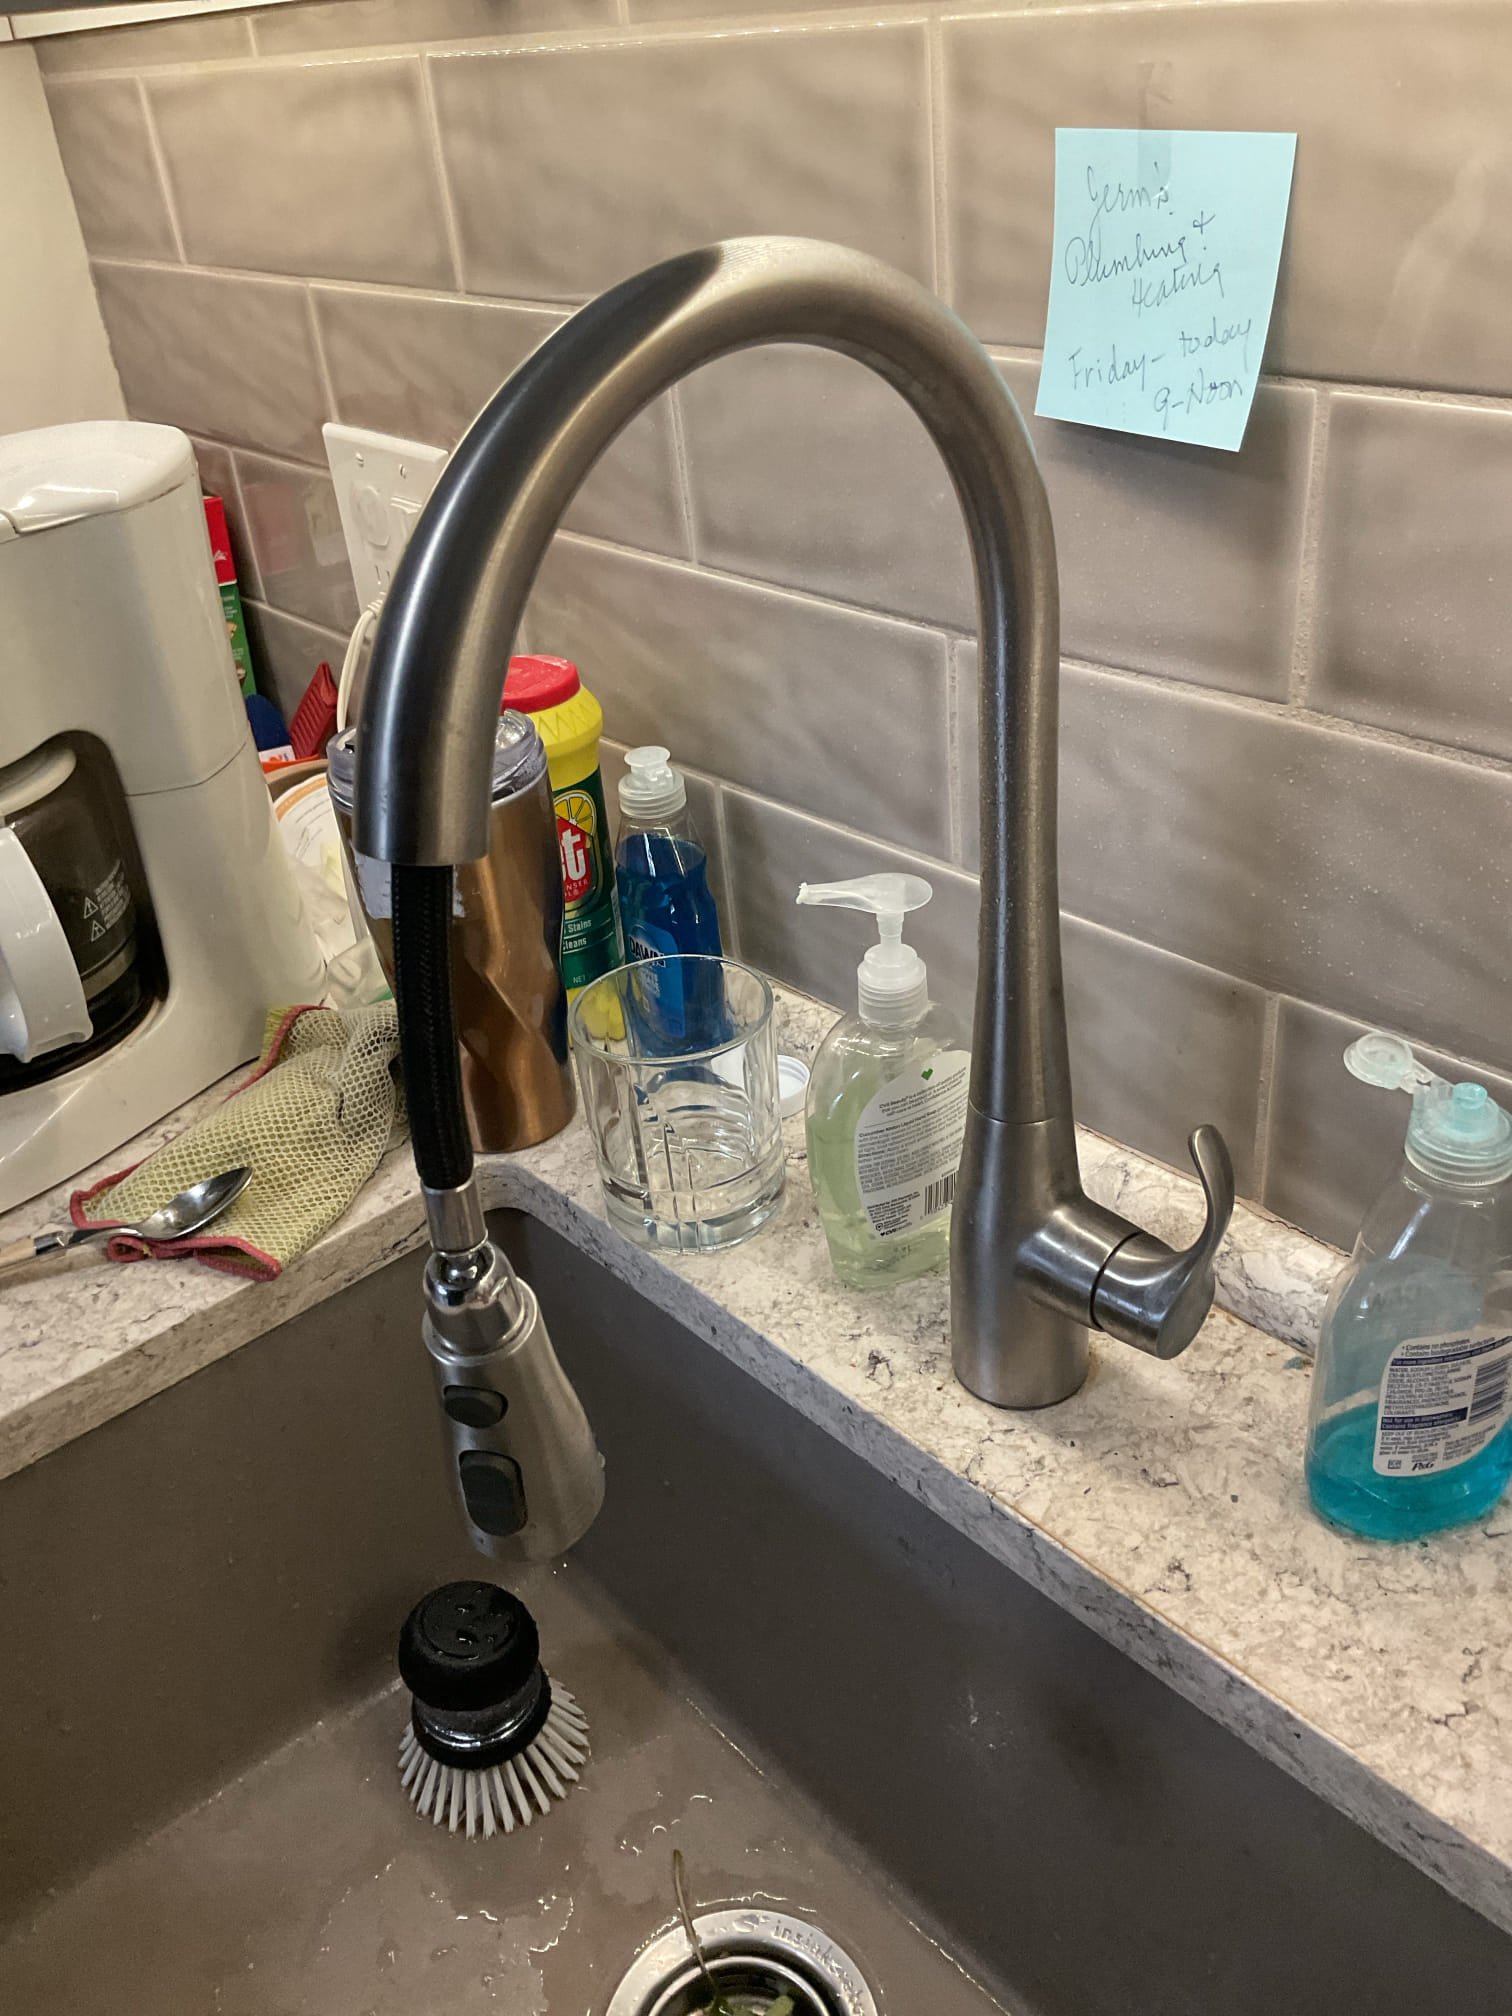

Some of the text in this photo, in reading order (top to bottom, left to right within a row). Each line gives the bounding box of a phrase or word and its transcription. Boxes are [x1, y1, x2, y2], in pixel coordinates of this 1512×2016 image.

[1131, 262, 1225, 318] Heating
[1178, 316, 1252, 374] today
[567, 918, 592, 933] Stains
